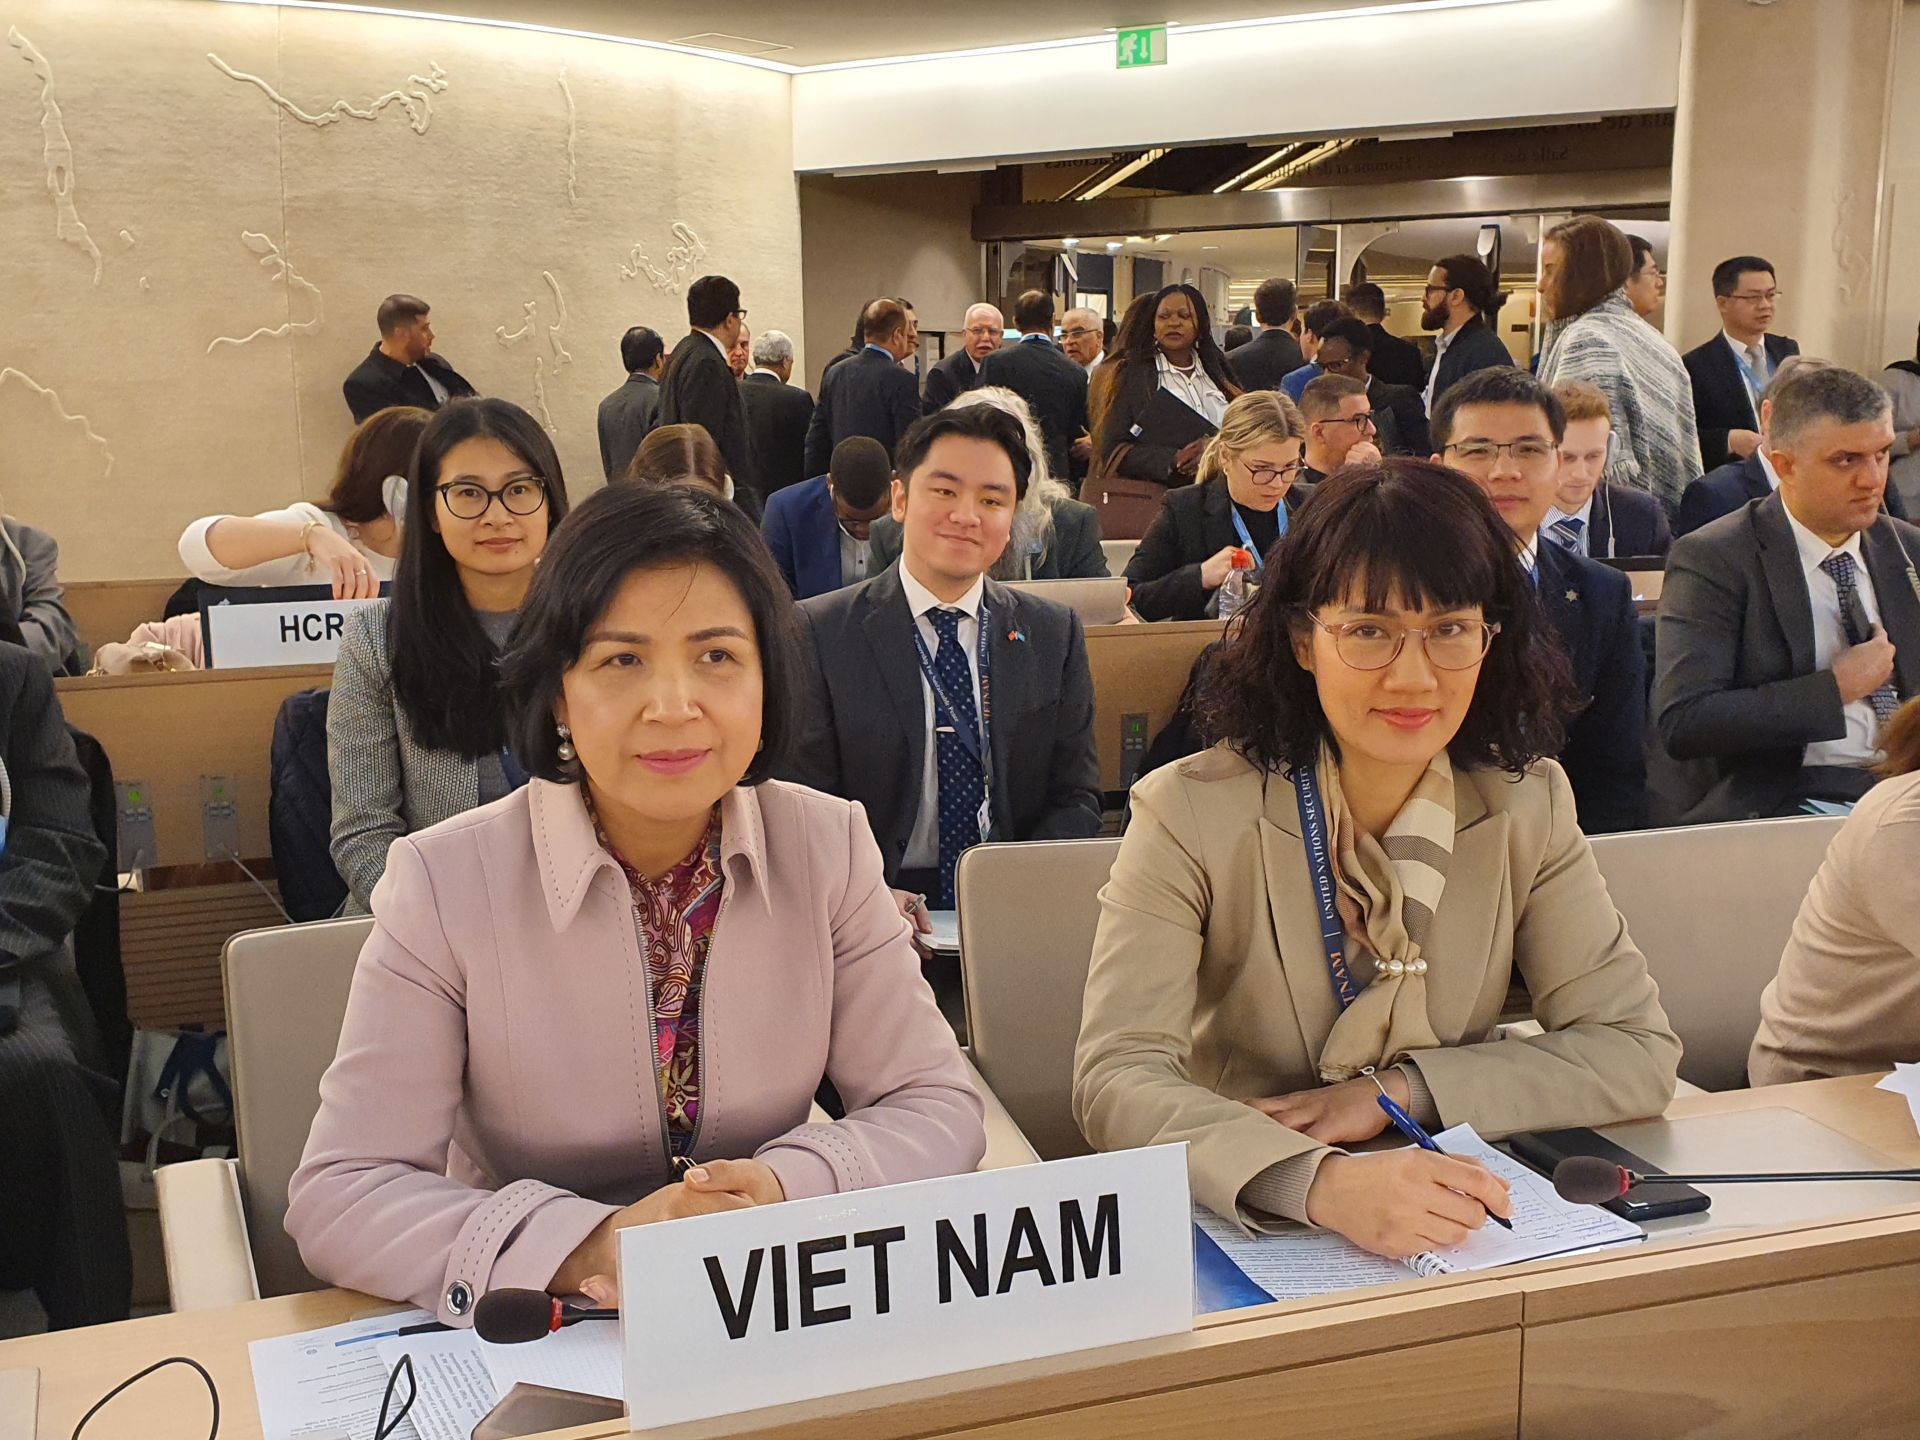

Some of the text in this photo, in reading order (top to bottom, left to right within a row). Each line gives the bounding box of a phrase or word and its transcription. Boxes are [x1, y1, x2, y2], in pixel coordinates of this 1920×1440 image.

[280, 613, 344, 642] HCR
[1310, 822, 1326, 874] NATIONS
[1319, 876, 1335, 920] UNITED
[703, 1226, 906, 1340] VIET
[935, 1193, 1122, 1304] NAM
